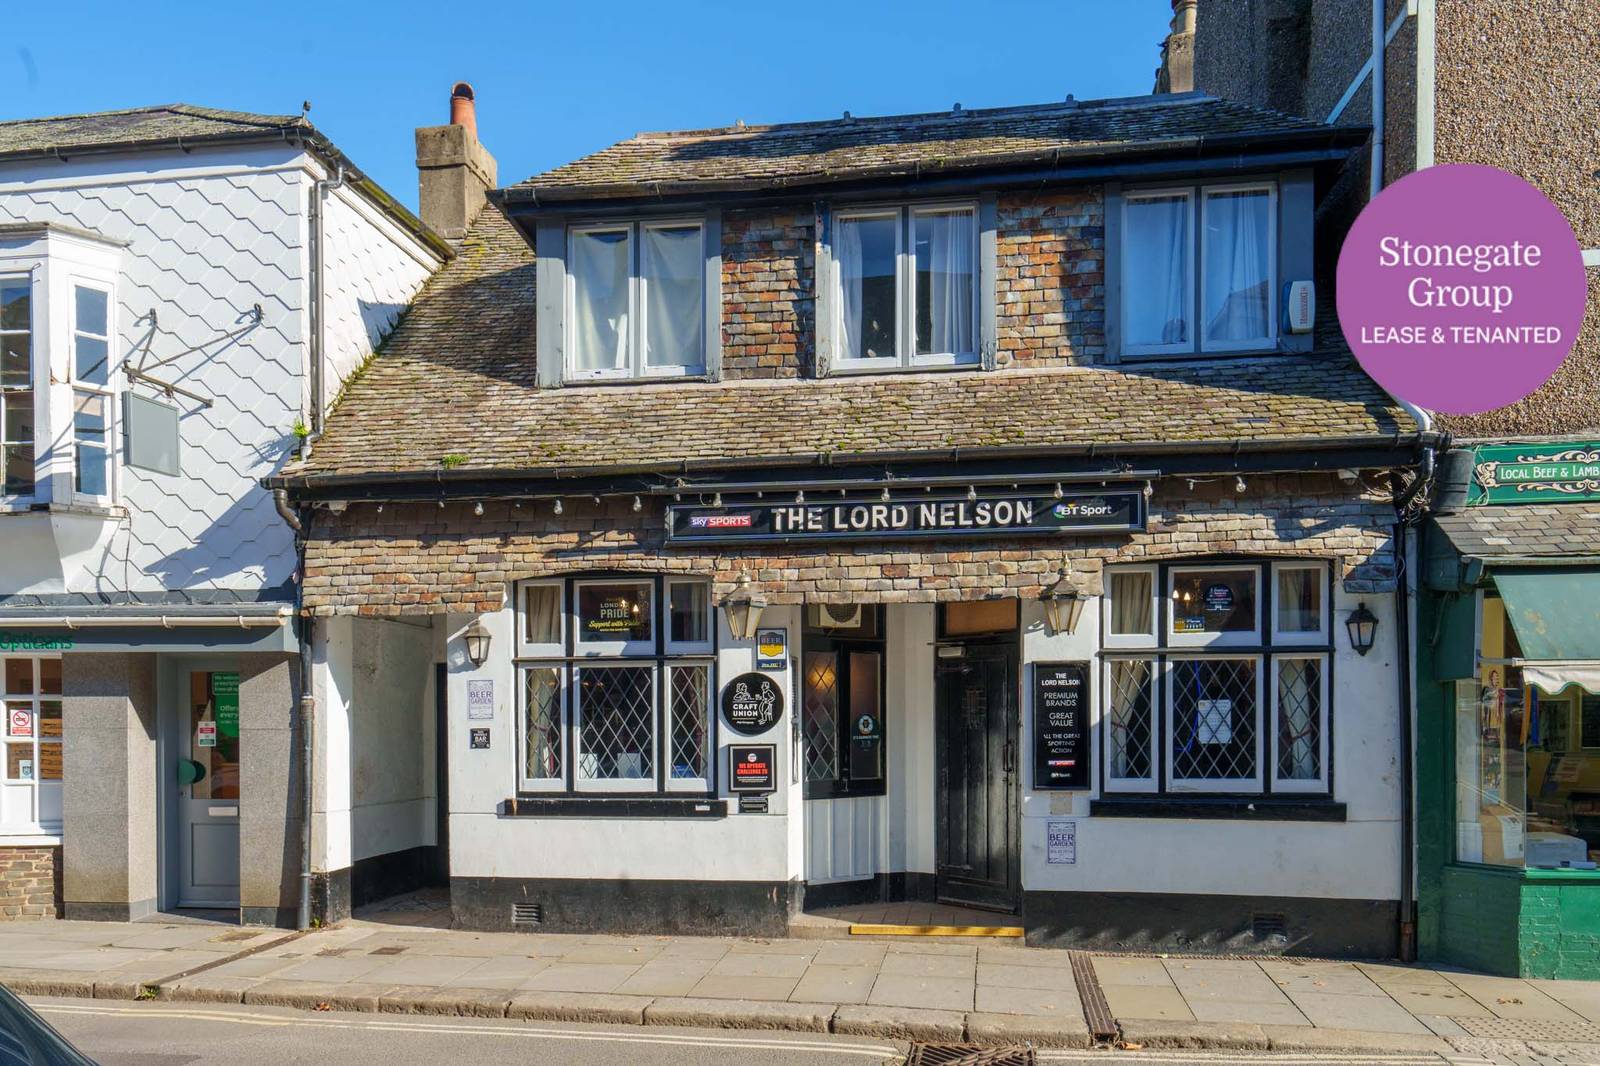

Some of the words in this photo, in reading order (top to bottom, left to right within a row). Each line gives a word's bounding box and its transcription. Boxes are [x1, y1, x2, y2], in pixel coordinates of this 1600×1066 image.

[1501, 467, 1530, 480] LOCAL
[1533, 466, 1558, 479] BEEF
[1560, 467, 1569, 477] &
[1572, 465, 1600, 477] LAMB
[1061, 506, 1079, 516] BT
[1080, 505, 1112, 517] Sport
[771, 507, 823, 531] THE
[834, 505, 908, 529] LORD
[920, 500, 1032, 527] NELSON
[691, 516, 707, 527] sky
[709, 515, 750, 526] SPORTS
[600, 609, 629, 618] PRIDE
[470, 690, 492, 698] BEER
[1046, 699, 1077, 707] BRANDS
[1049, 712, 1074, 720] GREAT
[1049, 719, 1074, 727] VALUE
[1050, 833, 1074, 841] BEER
